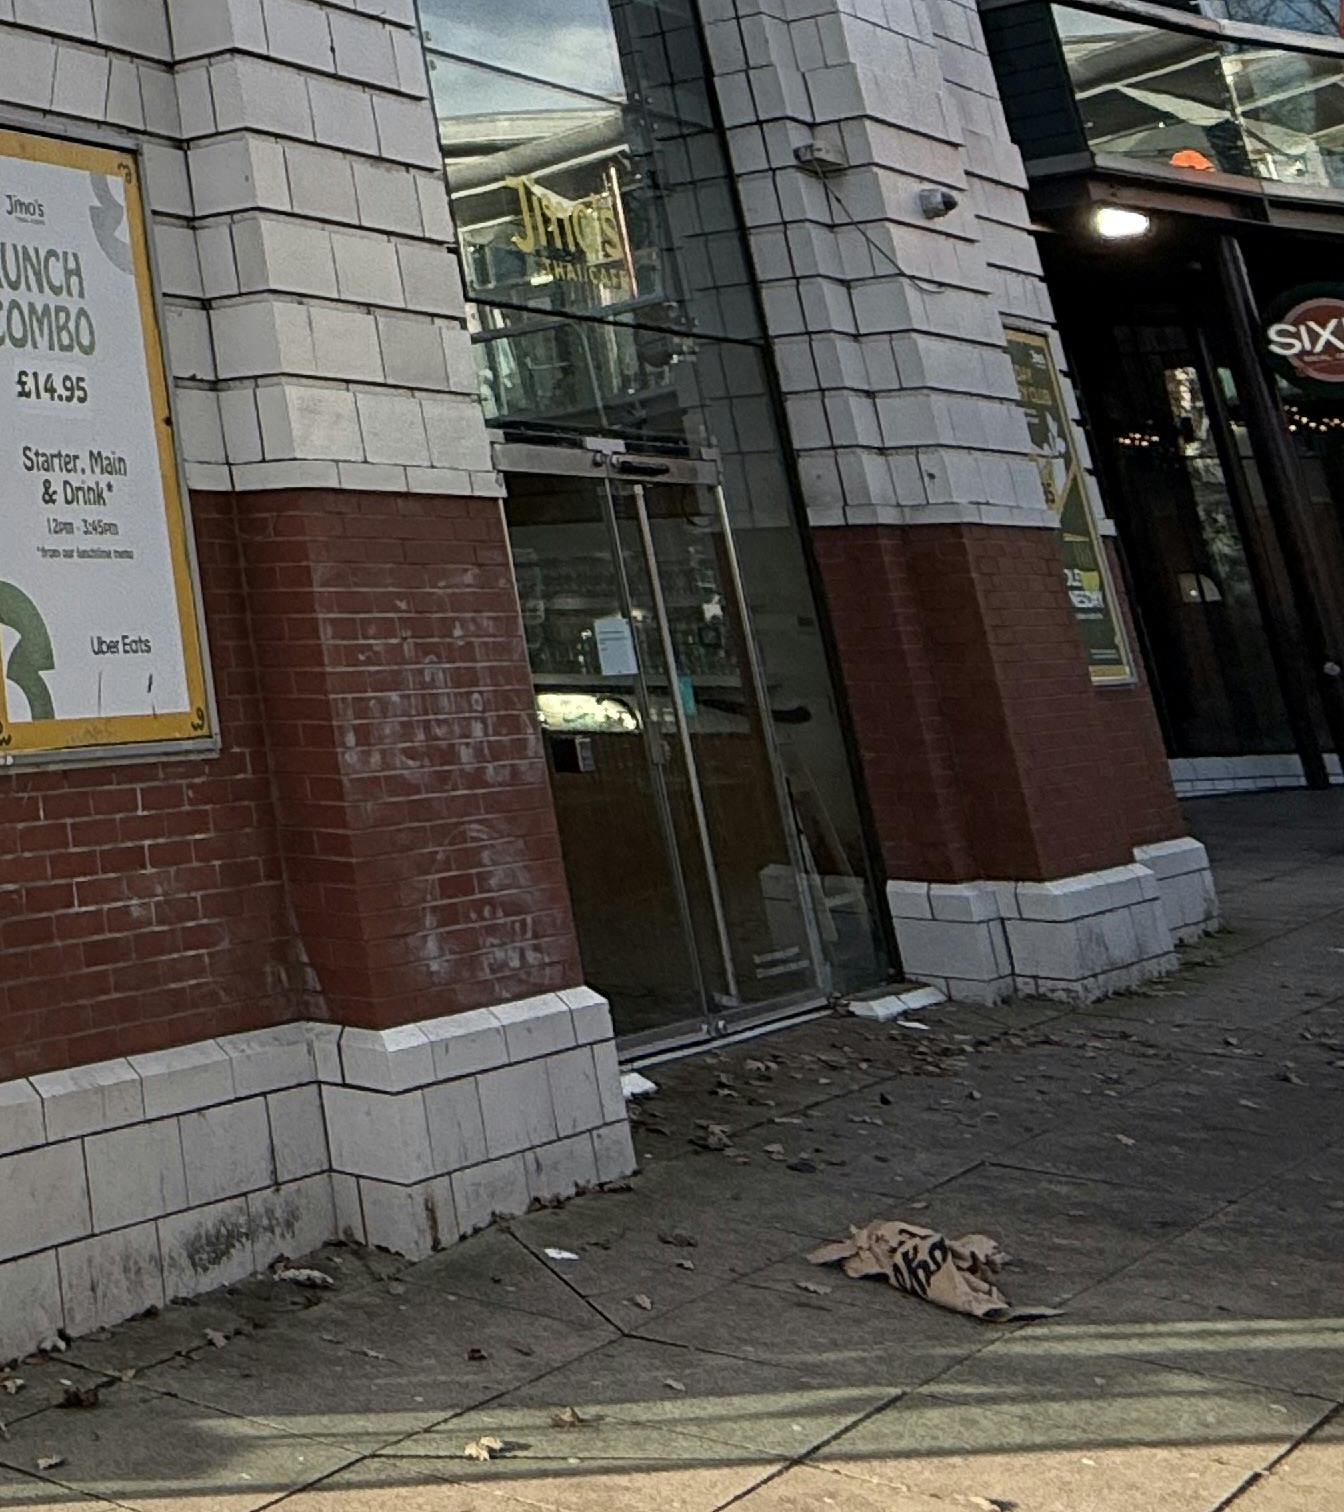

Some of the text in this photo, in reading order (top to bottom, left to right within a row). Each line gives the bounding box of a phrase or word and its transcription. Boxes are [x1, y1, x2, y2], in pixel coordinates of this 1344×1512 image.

[1267, 317, 1344, 356] SIX
[16, 370, 88, 403] £14.95
[88, 449, 128, 477] Main
[42, 478, 58, 505] &
[91, 634, 152, 655] Uber Eats
